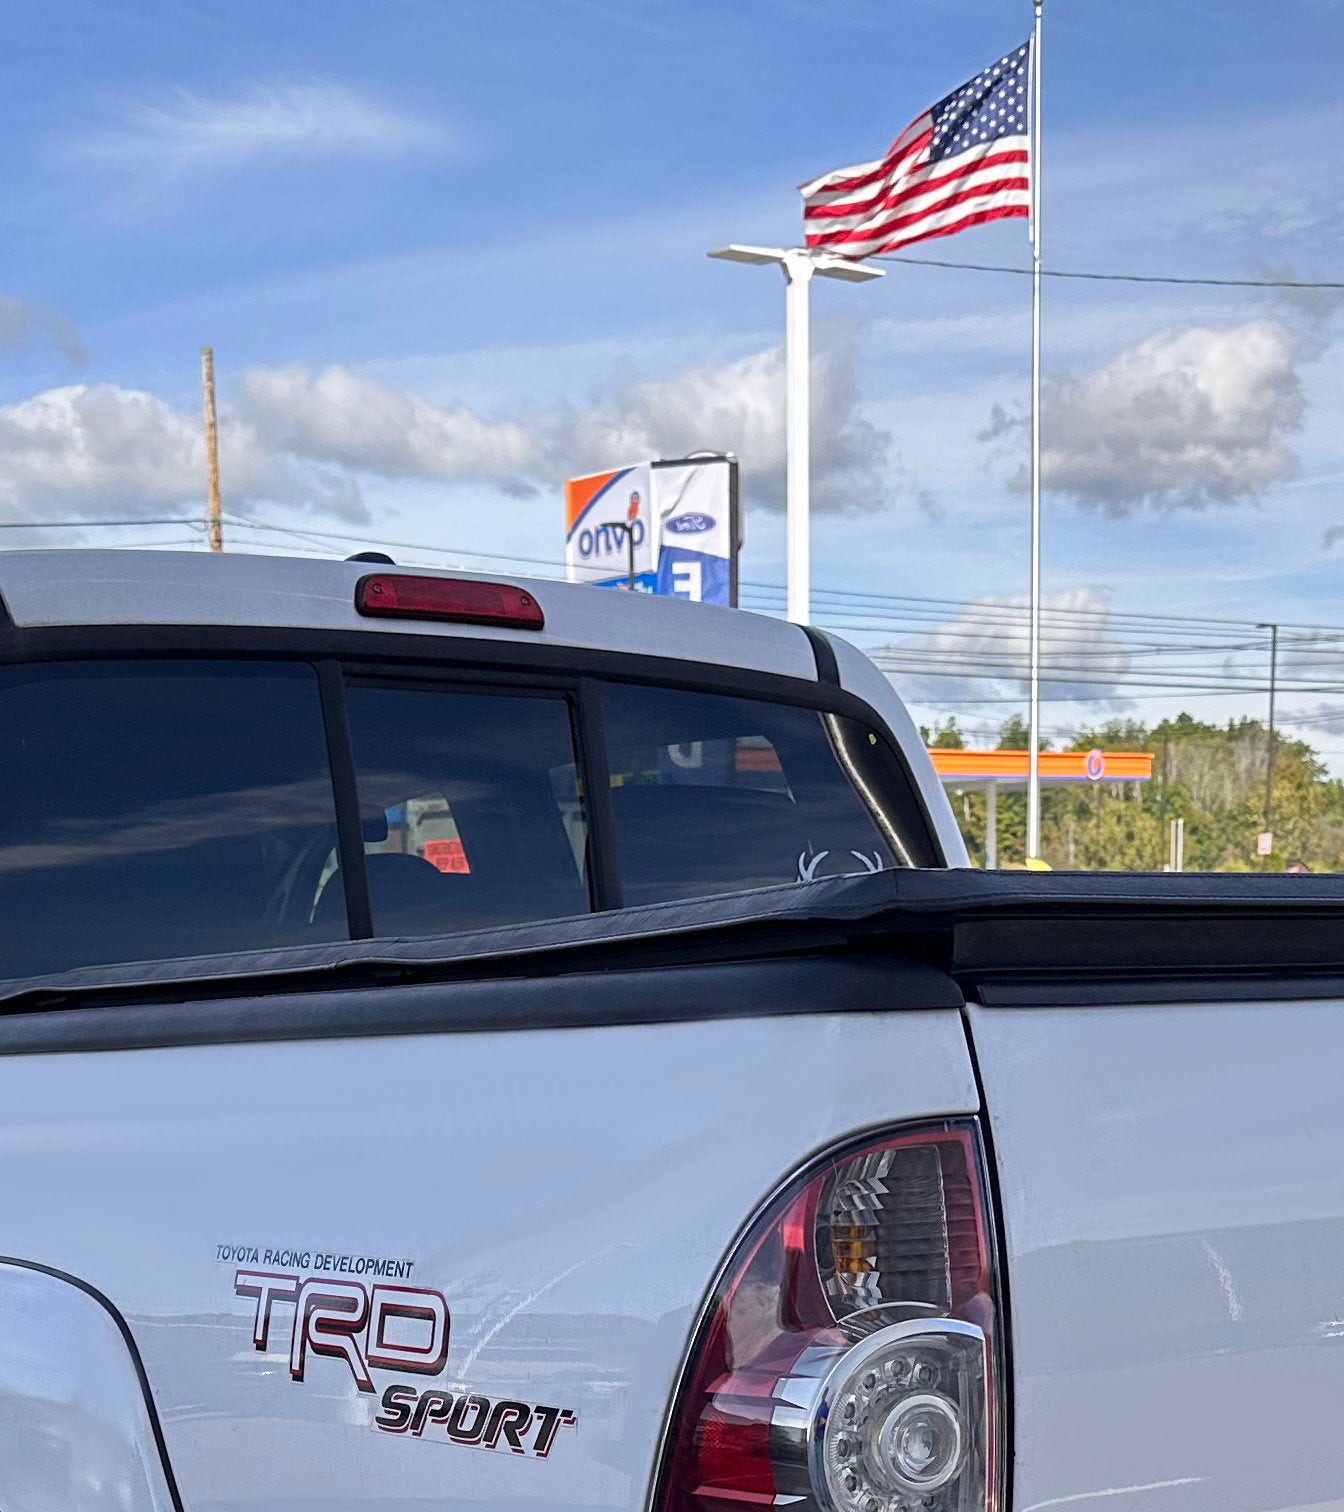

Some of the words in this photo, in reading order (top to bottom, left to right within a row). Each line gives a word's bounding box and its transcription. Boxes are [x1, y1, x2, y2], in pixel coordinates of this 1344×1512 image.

[579, 519, 645, 558] onvo
[216, 1244, 258, 1263] TOYOTA
[263, 1249, 310, 1269] RACING
[314, 1254, 414, 1279] DEVELOPMENT
[234, 1269, 451, 1394] TRD
[375, 1384, 578, 1459] SPORT
